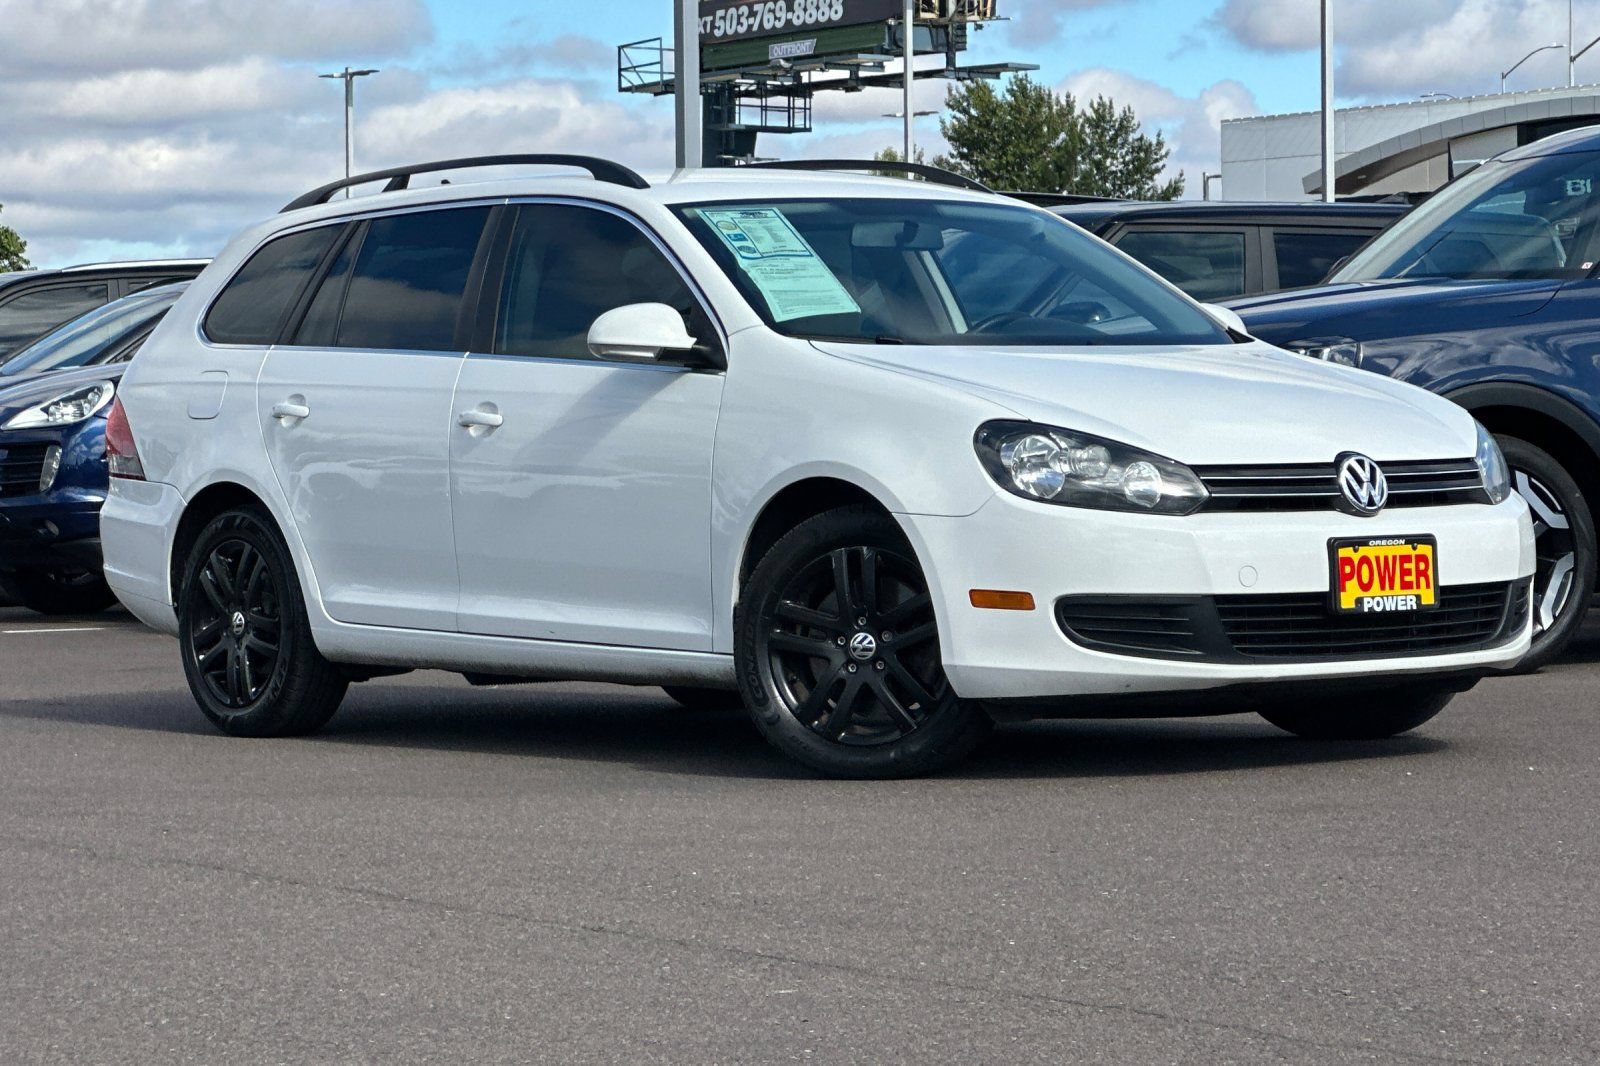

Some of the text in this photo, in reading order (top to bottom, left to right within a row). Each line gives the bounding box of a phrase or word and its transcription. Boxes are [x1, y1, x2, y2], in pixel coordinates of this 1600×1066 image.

[714, 0, 844, 37] 503-769-8888
[1340, 554, 1431, 592] POWER
[1363, 595, 1417, 612] POWER
